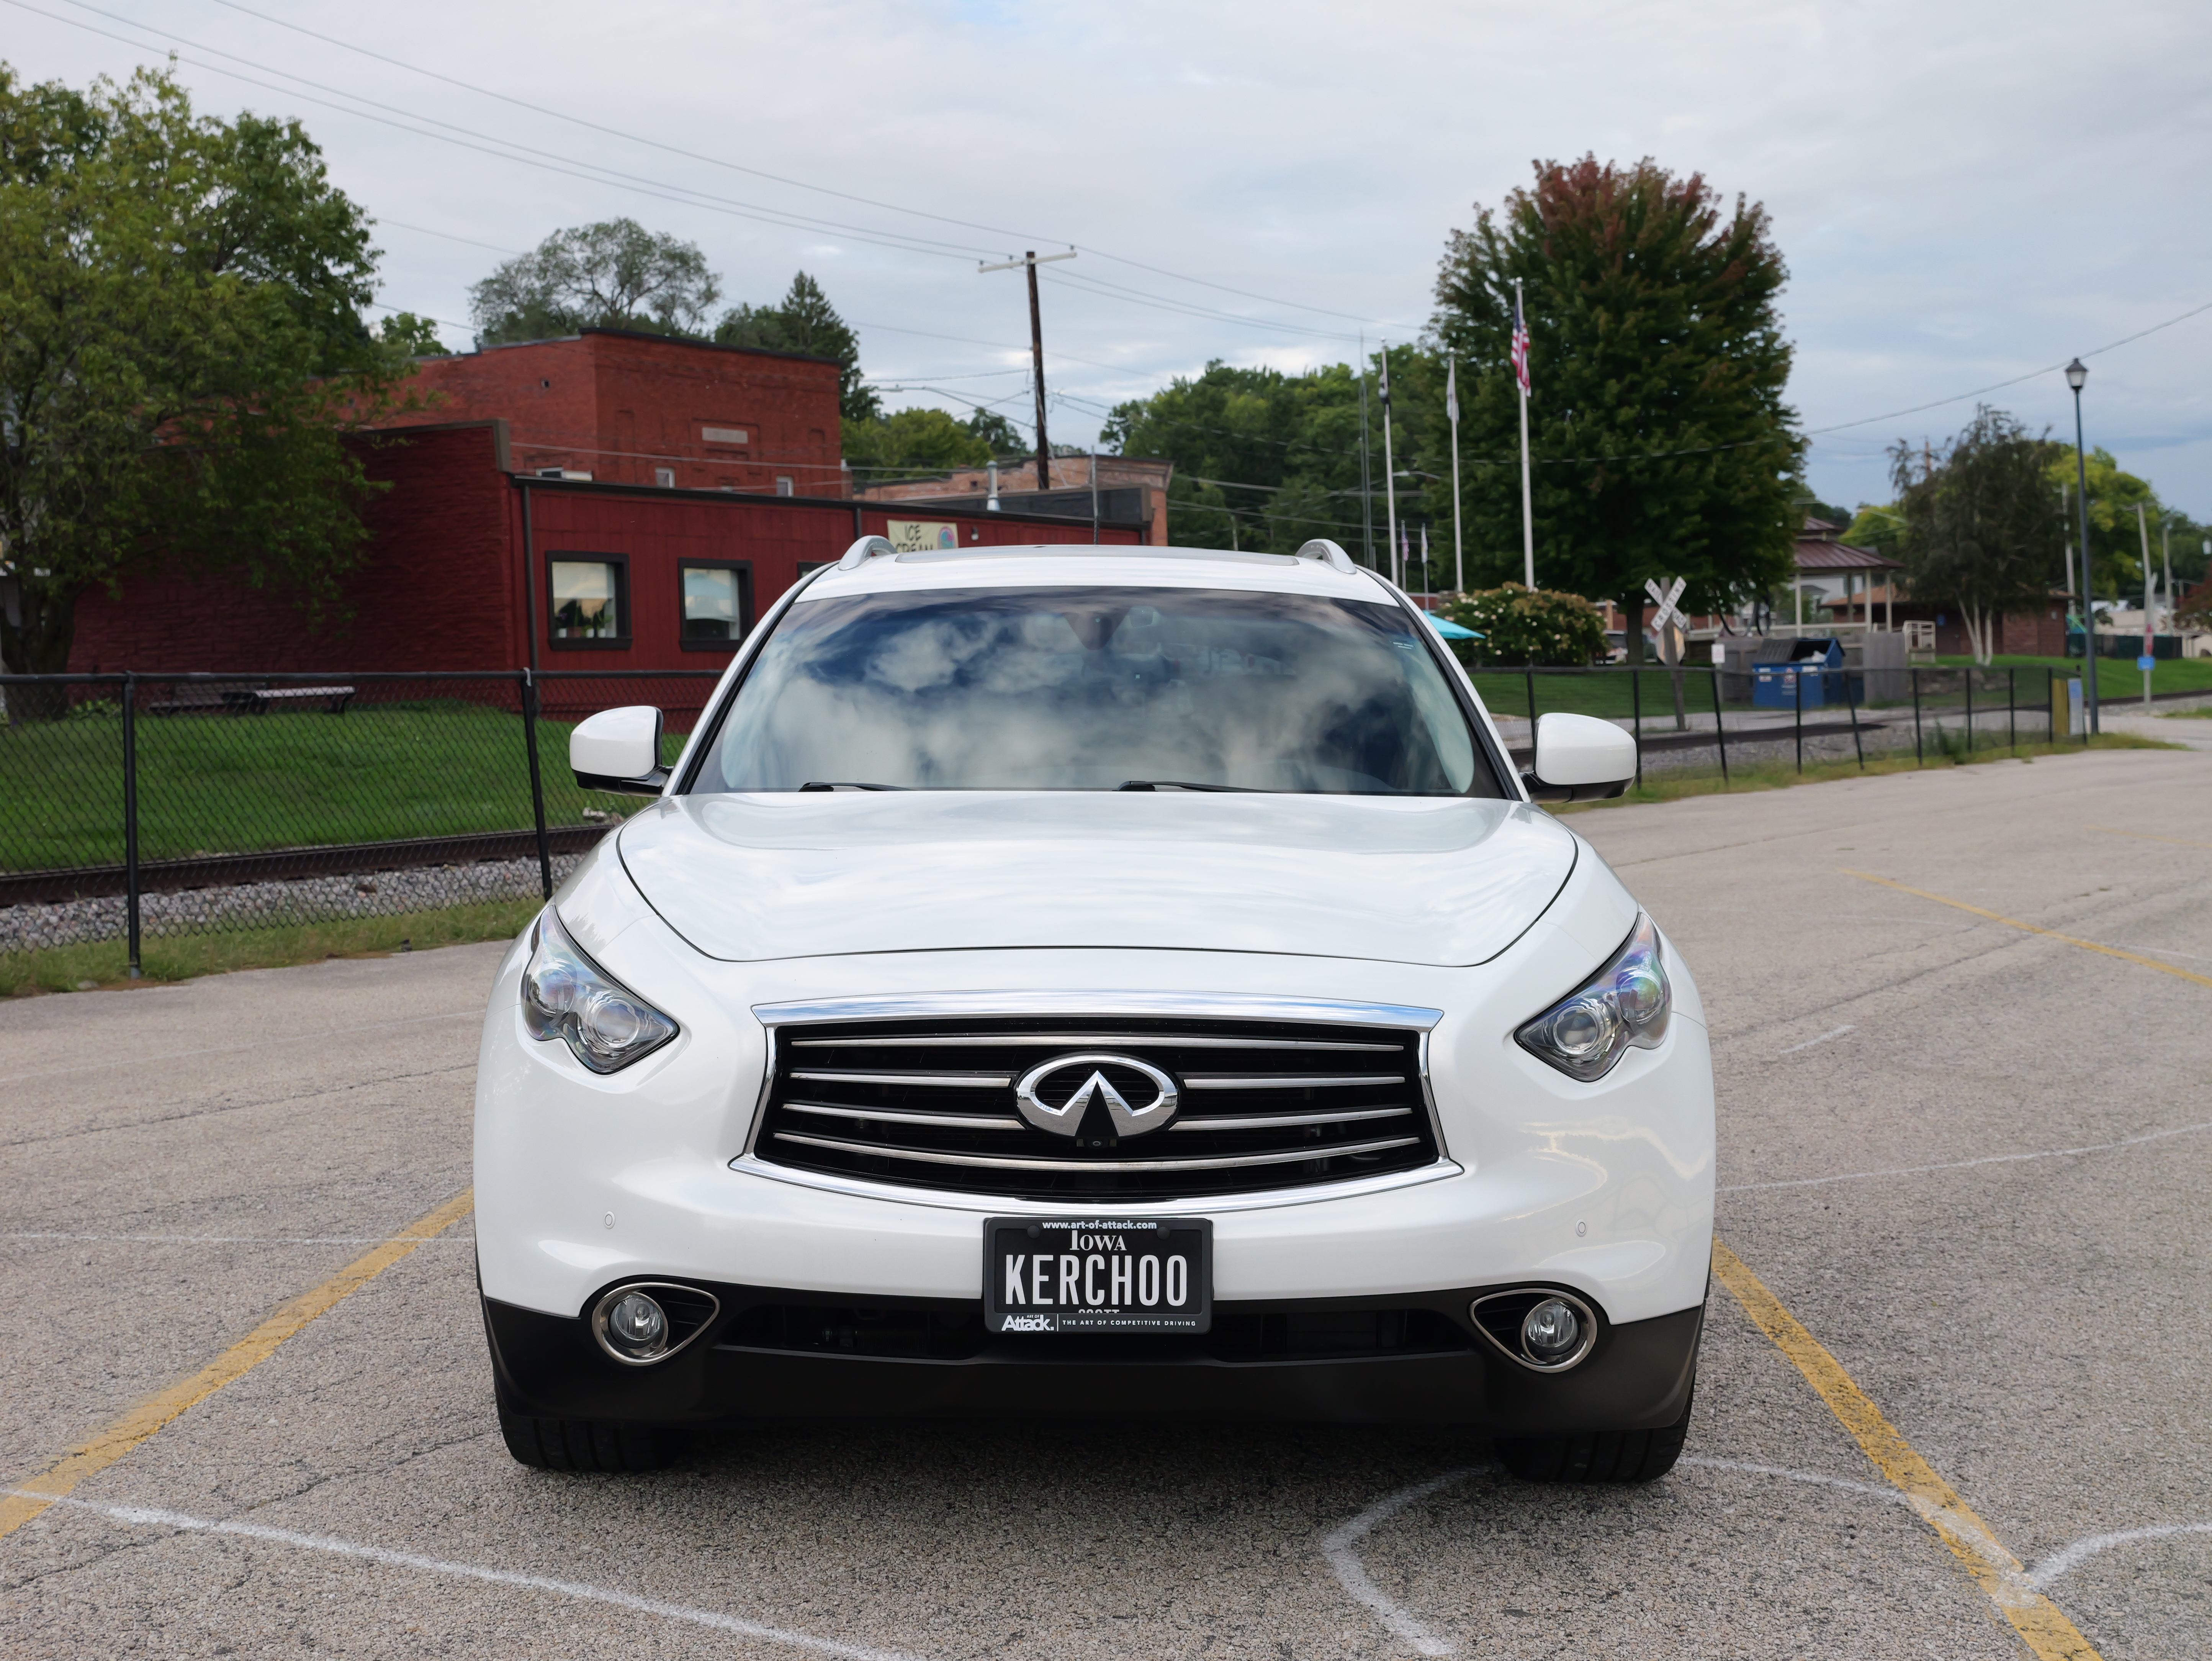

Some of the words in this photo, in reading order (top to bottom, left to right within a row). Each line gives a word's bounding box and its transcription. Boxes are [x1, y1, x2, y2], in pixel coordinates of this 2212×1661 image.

[905, 524, 921, 541] ICE
[1042, 1220, 1157, 1229] www.art-of-attack.com
[1006, 1254, 1187, 1306] KERCHOO
